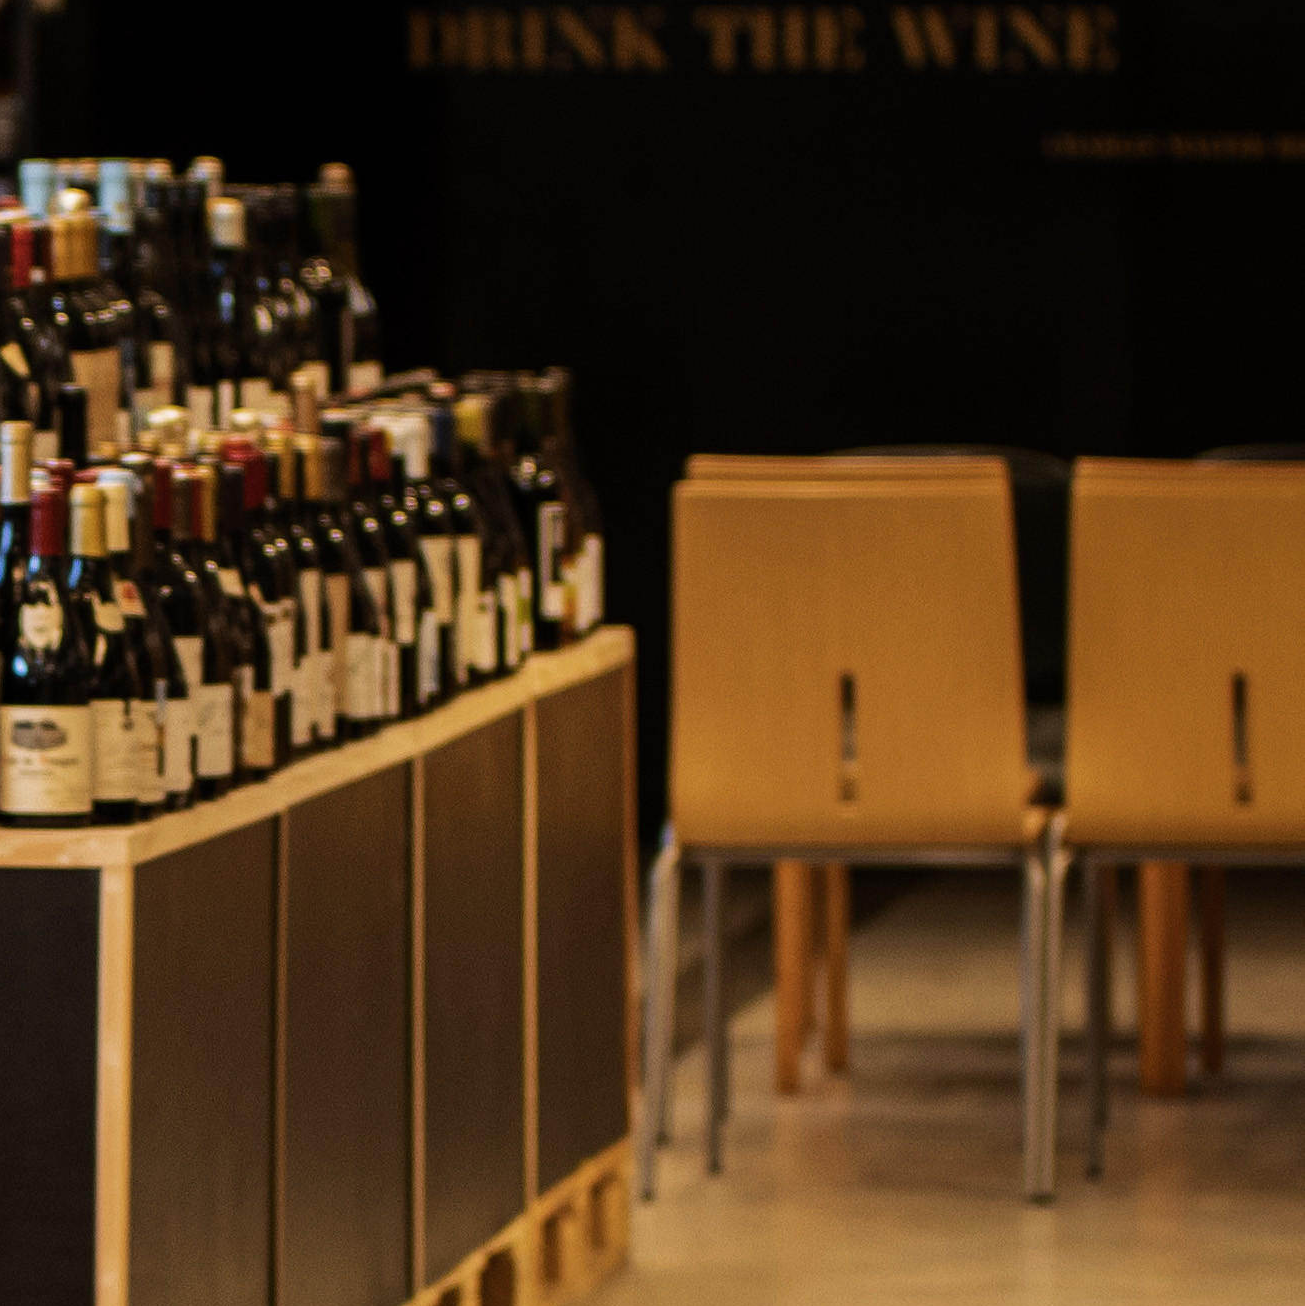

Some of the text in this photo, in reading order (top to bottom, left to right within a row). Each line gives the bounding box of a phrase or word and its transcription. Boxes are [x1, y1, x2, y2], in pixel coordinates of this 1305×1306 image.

[407, 4, 1120, 72] DRINK THE WINE
